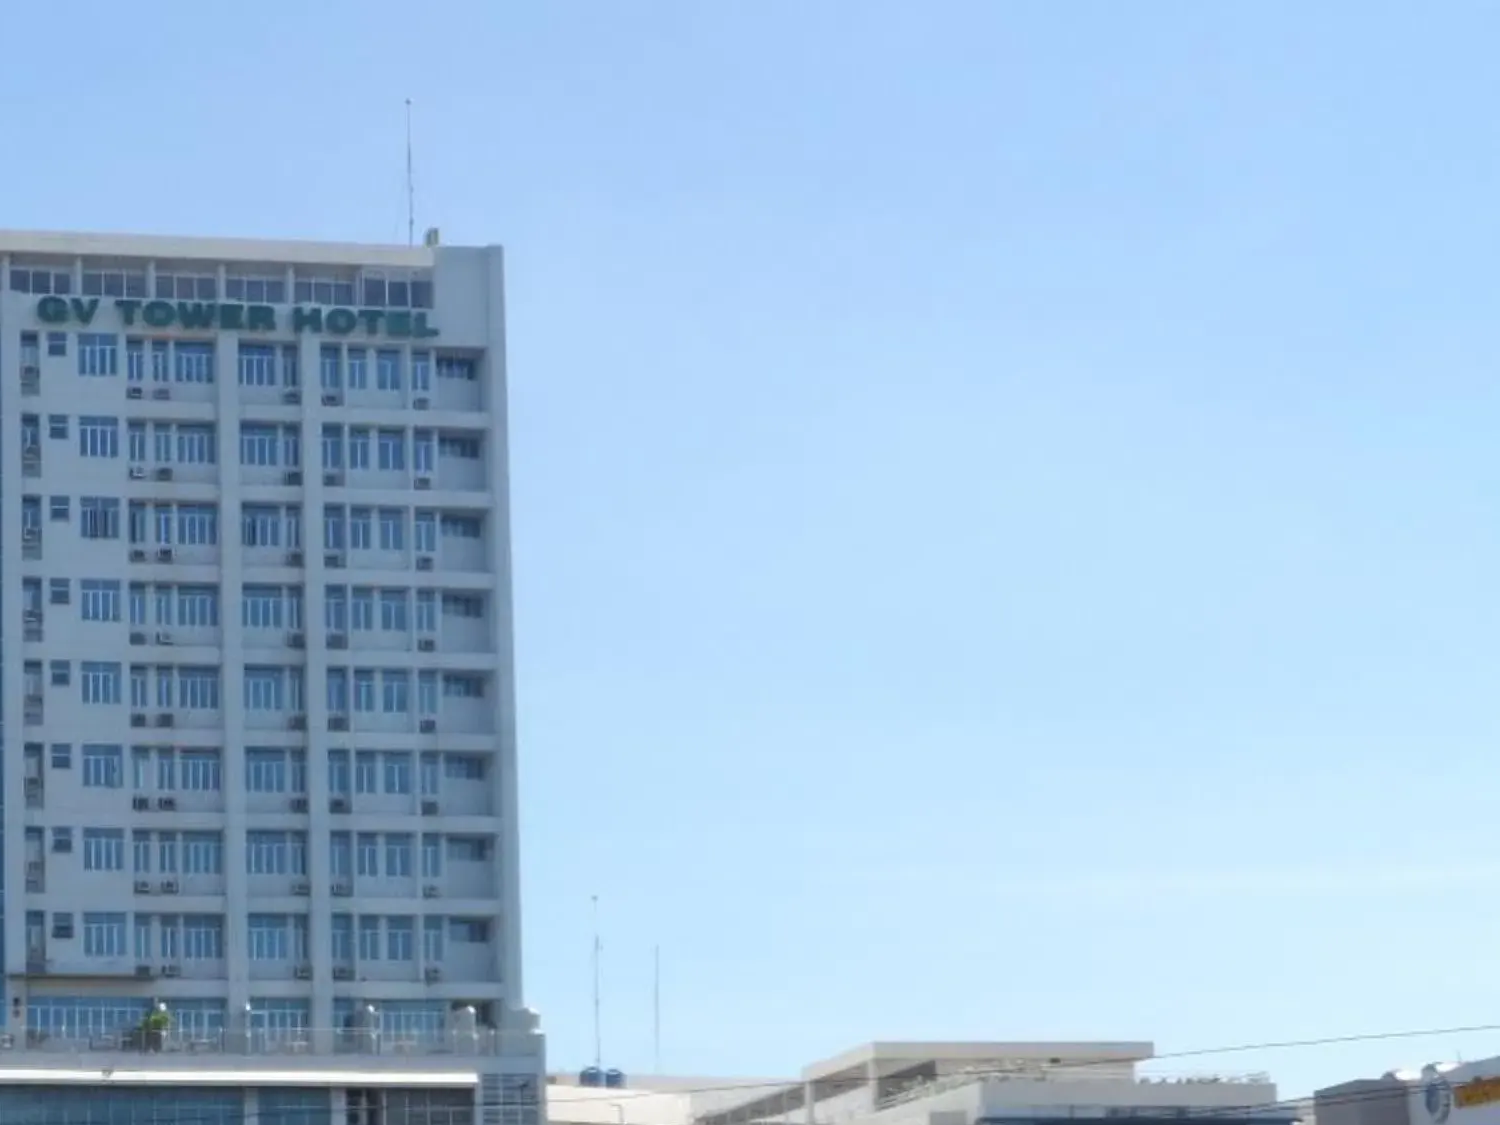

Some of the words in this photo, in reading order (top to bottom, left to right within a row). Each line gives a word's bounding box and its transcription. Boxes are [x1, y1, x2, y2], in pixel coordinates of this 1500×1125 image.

[37, 295, 99, 327] GV
[114, 299, 276, 331] TOWER
[293, 306, 440, 338] HOTEL
